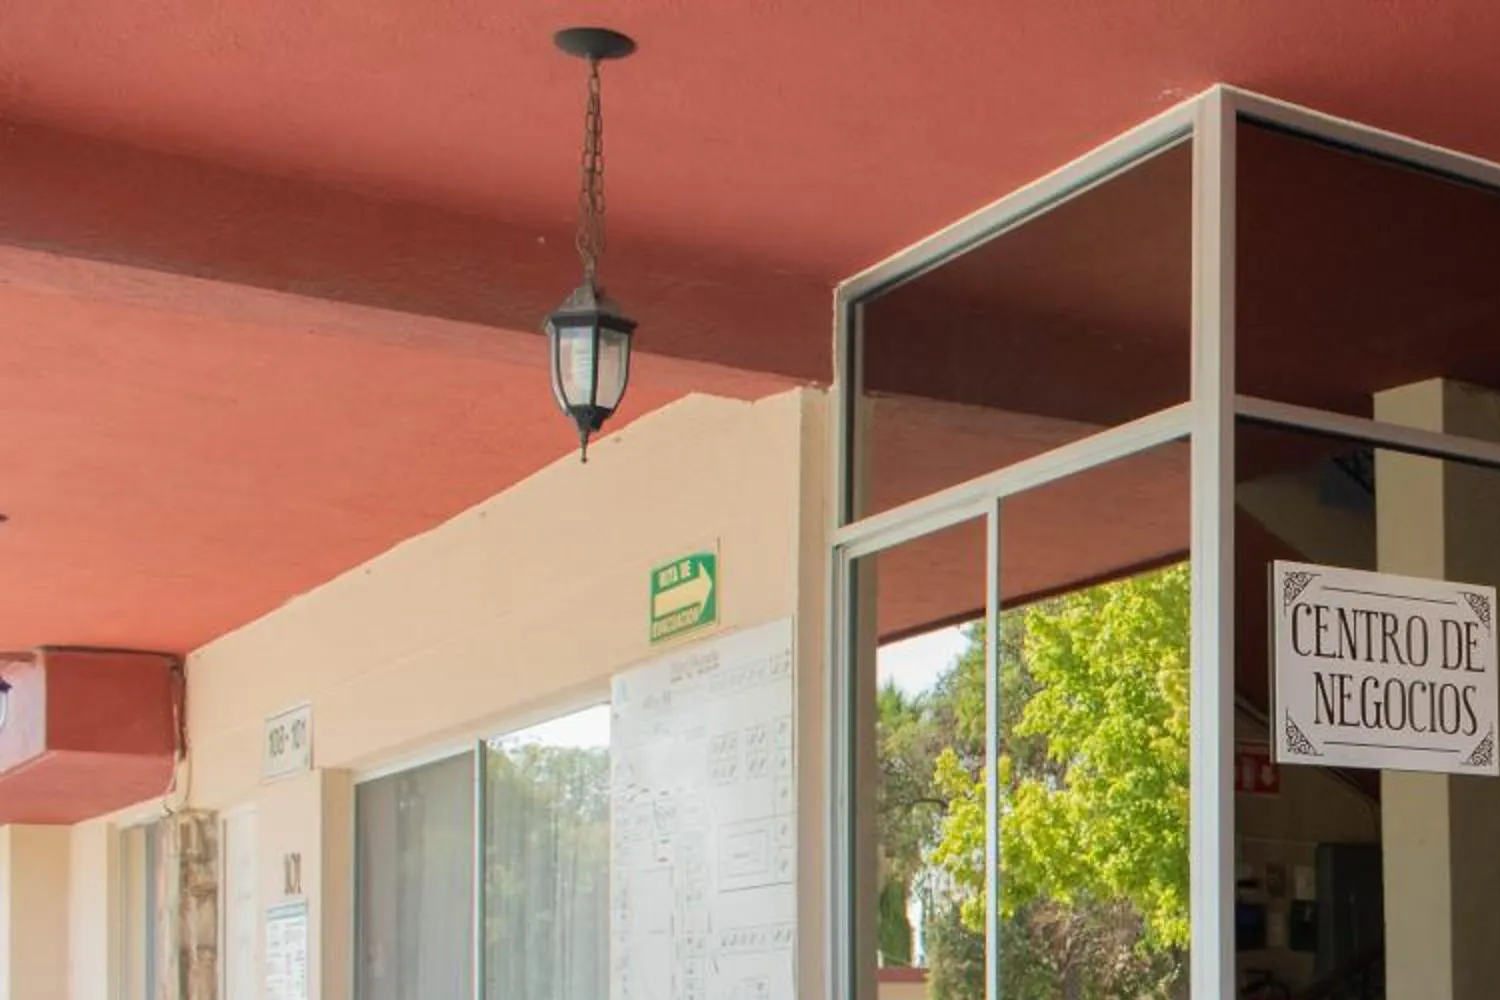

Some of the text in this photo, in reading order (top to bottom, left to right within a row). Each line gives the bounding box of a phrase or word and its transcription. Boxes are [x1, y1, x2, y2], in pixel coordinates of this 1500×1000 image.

[1291, 602, 1485, 673] CENTRO DE
[1314, 671, 1477, 736] NEGOCIOS
[282, 852, 302, 894] 101
